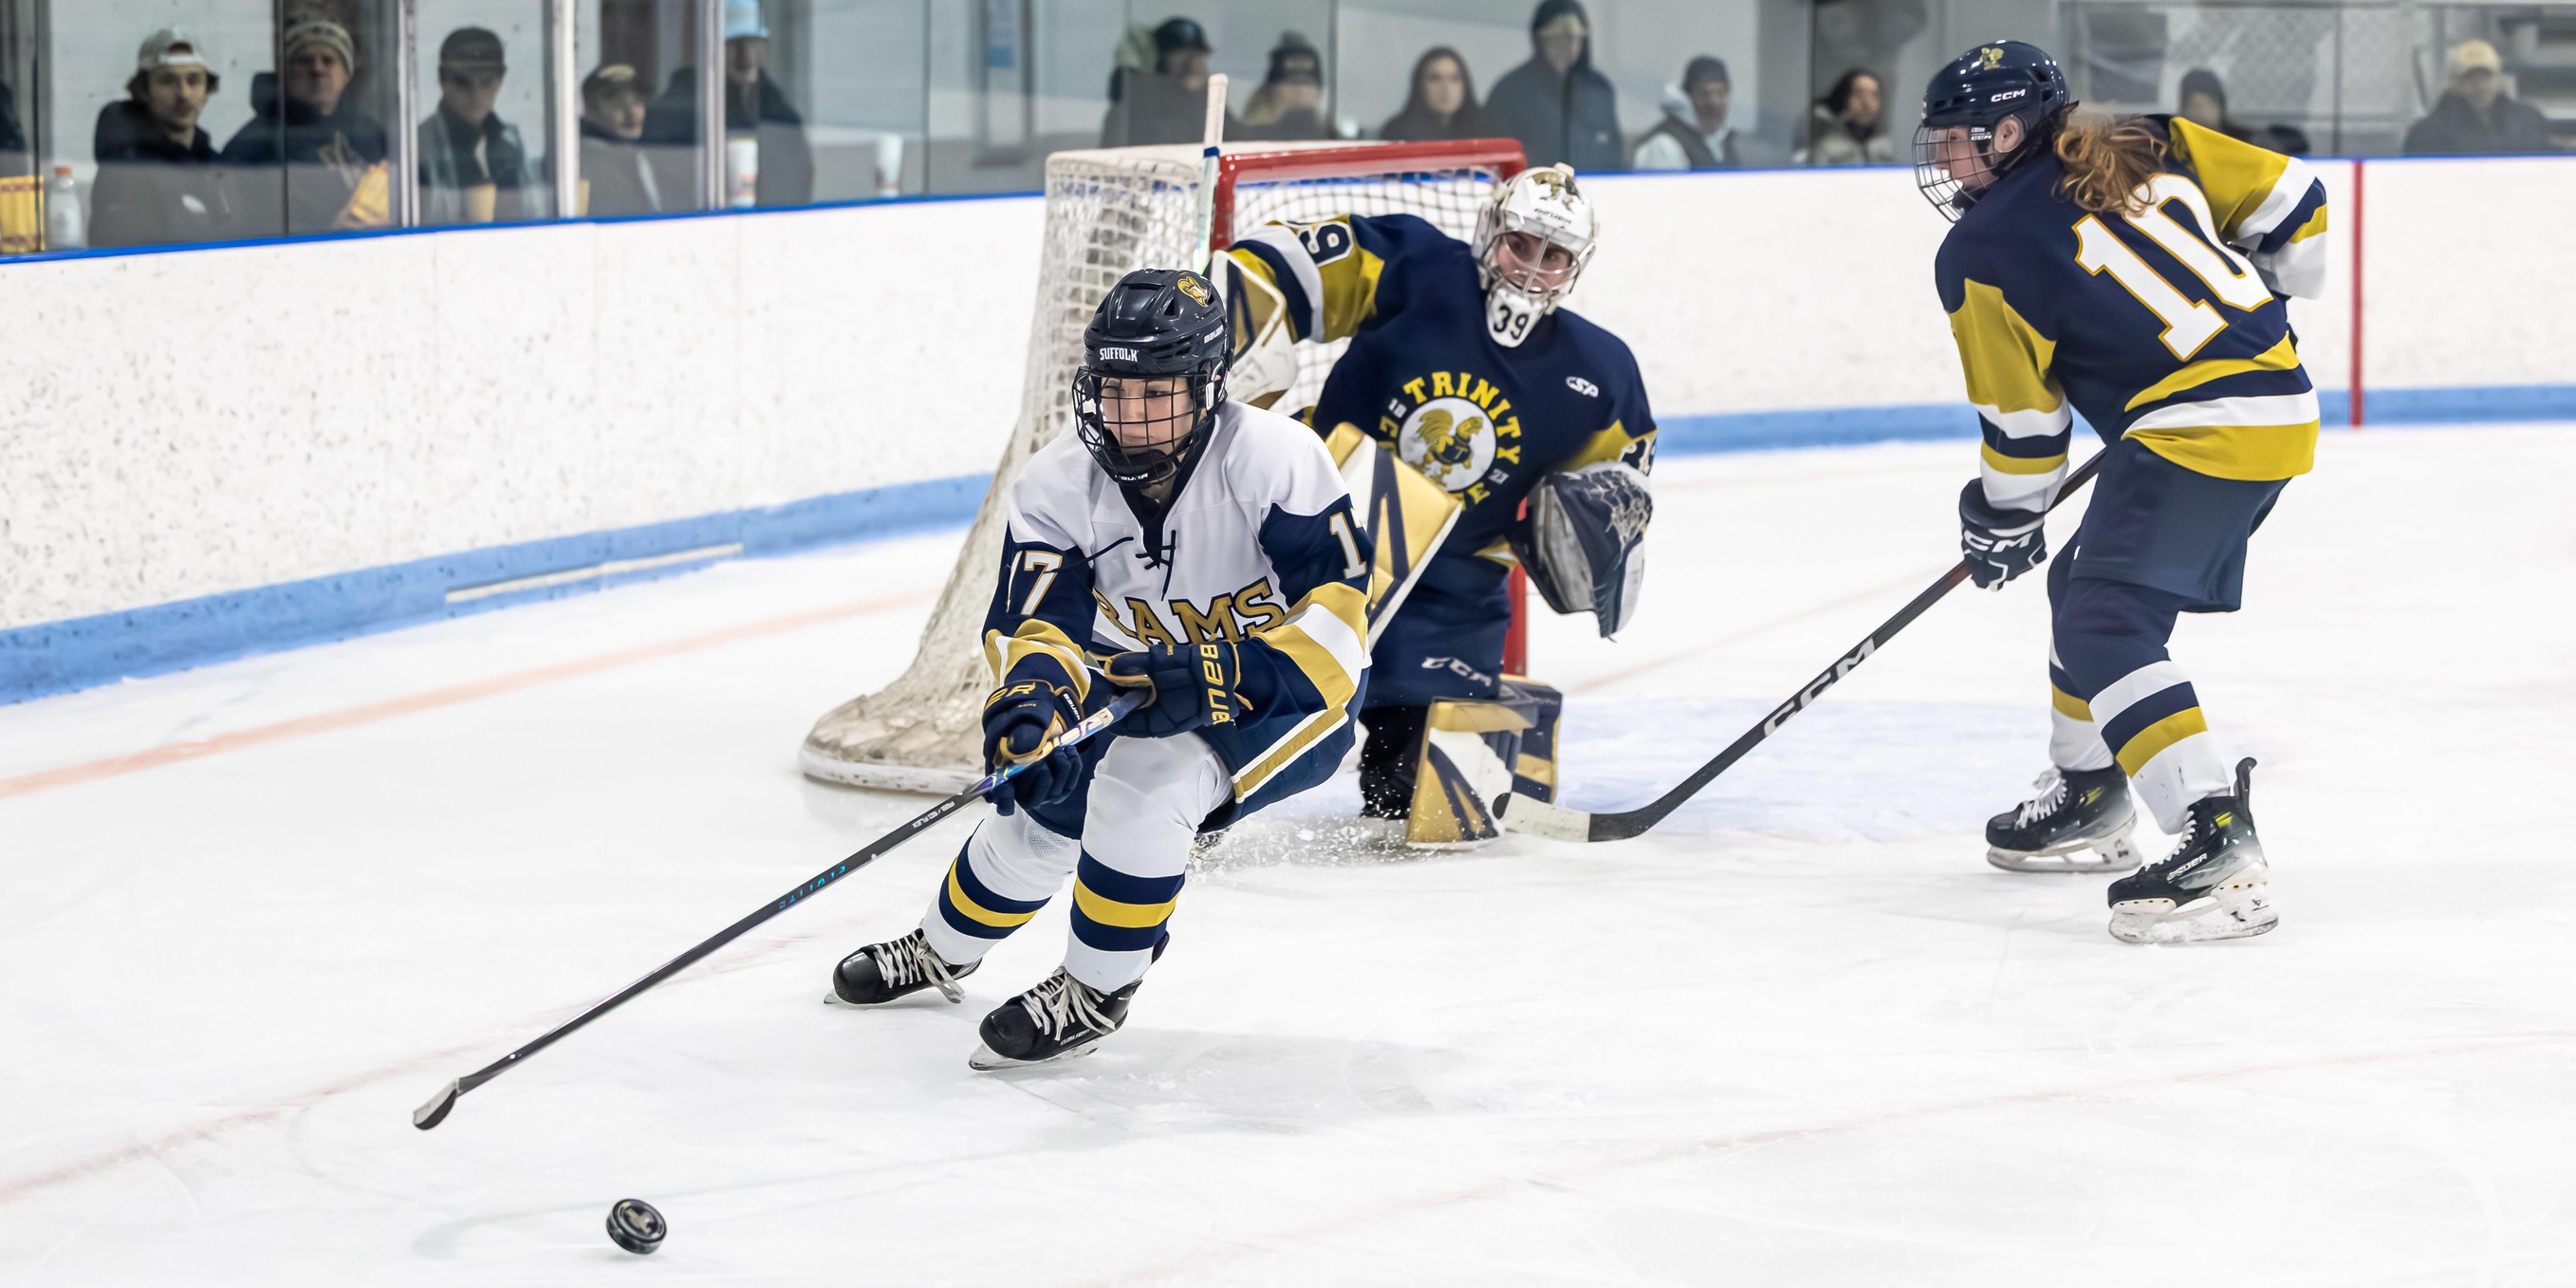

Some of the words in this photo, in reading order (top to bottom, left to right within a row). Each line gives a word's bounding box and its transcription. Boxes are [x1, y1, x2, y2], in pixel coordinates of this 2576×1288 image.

[1991, 88, 2027, 103] CCM
[2071, 172, 2274, 362] 10
[1492, 304, 1529, 340] 39
[1099, 346, 1139, 363] SUFFOLK
[1402, 371, 1522, 465] TRINITY
[1763, 637, 1876, 738] CCM
[1063, 693, 1081, 721] BAUER
